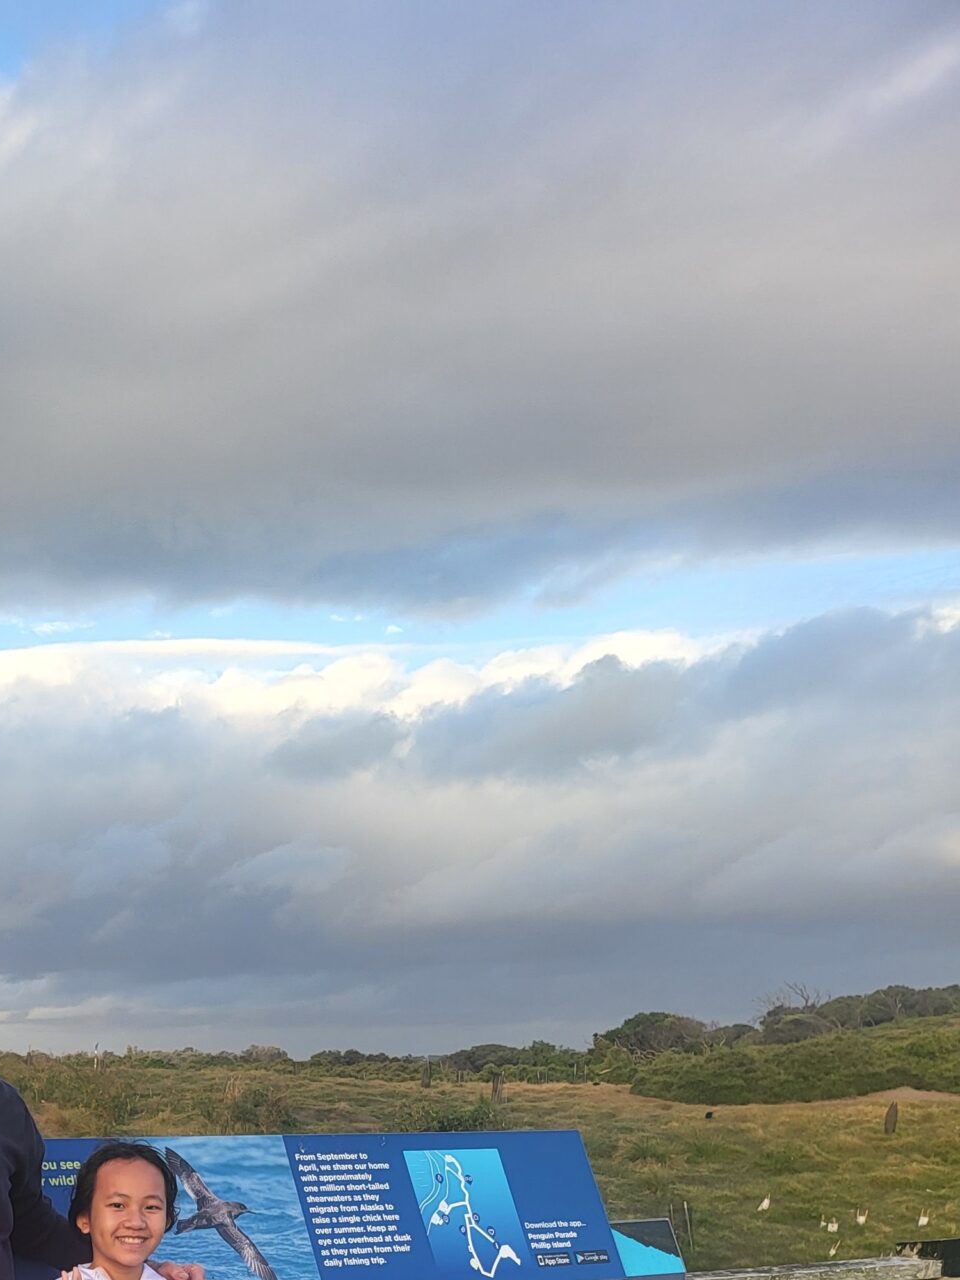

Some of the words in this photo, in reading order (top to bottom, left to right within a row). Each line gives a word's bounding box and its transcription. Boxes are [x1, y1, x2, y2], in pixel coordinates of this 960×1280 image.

[294, 1153, 316, 1161] From
[317, 1153, 358, 1162] September
[42, 1161, 57, 1170] ou
[60, 1161, 81, 1170] see
[298, 1163, 320, 1172] April,
[332, 1163, 353, 1171] share
[368, 1162, 390, 1170] home
[300, 1174, 318, 1182] with
[319, 1173, 372, 1182] approximately
[320, 1183, 346, 1192] million
[346, 1182, 390, 1191] short-tailed
[306, 1194, 352, 1203] shearwaters
[363, 1193, 380, 1202] they
[309, 1205, 339, 1214] migrate
[340, 1204, 359, 1212] from
[360, 1203, 385, 1211] Alaska
[385, 1203, 394, 1211] to
[312, 1216, 331, 1224] raise
[338, 1215, 361, 1224] single
[361, 1214, 382, 1222] chick
[382, 1213, 400, 1221] here
[333, 1226, 366, 1234] summer.
[366, 1225, 387, 1233] Keep
[524, 1221, 557, 1229] Download
[318, 1238, 332, 1246] eye
[348, 1235, 383, 1244] overhead
[393, 1233, 412, 1241] dusk
[528, 1232, 555, 1240] Penguin
[554, 1231, 578, 1239] Parade
[530, 1241, 551, 1249] Phillip
[551, 1240, 572, 1248] Island
[331, 1247, 348, 1256] they
[349, 1246, 373, 1254] return
[373, 1245, 393, 1253] from
[393, 1244, 411, 1252] their
[323, 1259, 343, 1267] daily
[343, 1257, 370, 1266] fishing
[371, 1256, 387, 1265] trip.
[544, 1257, 556, 1265] App
[556, 1257, 570, 1265] Store
